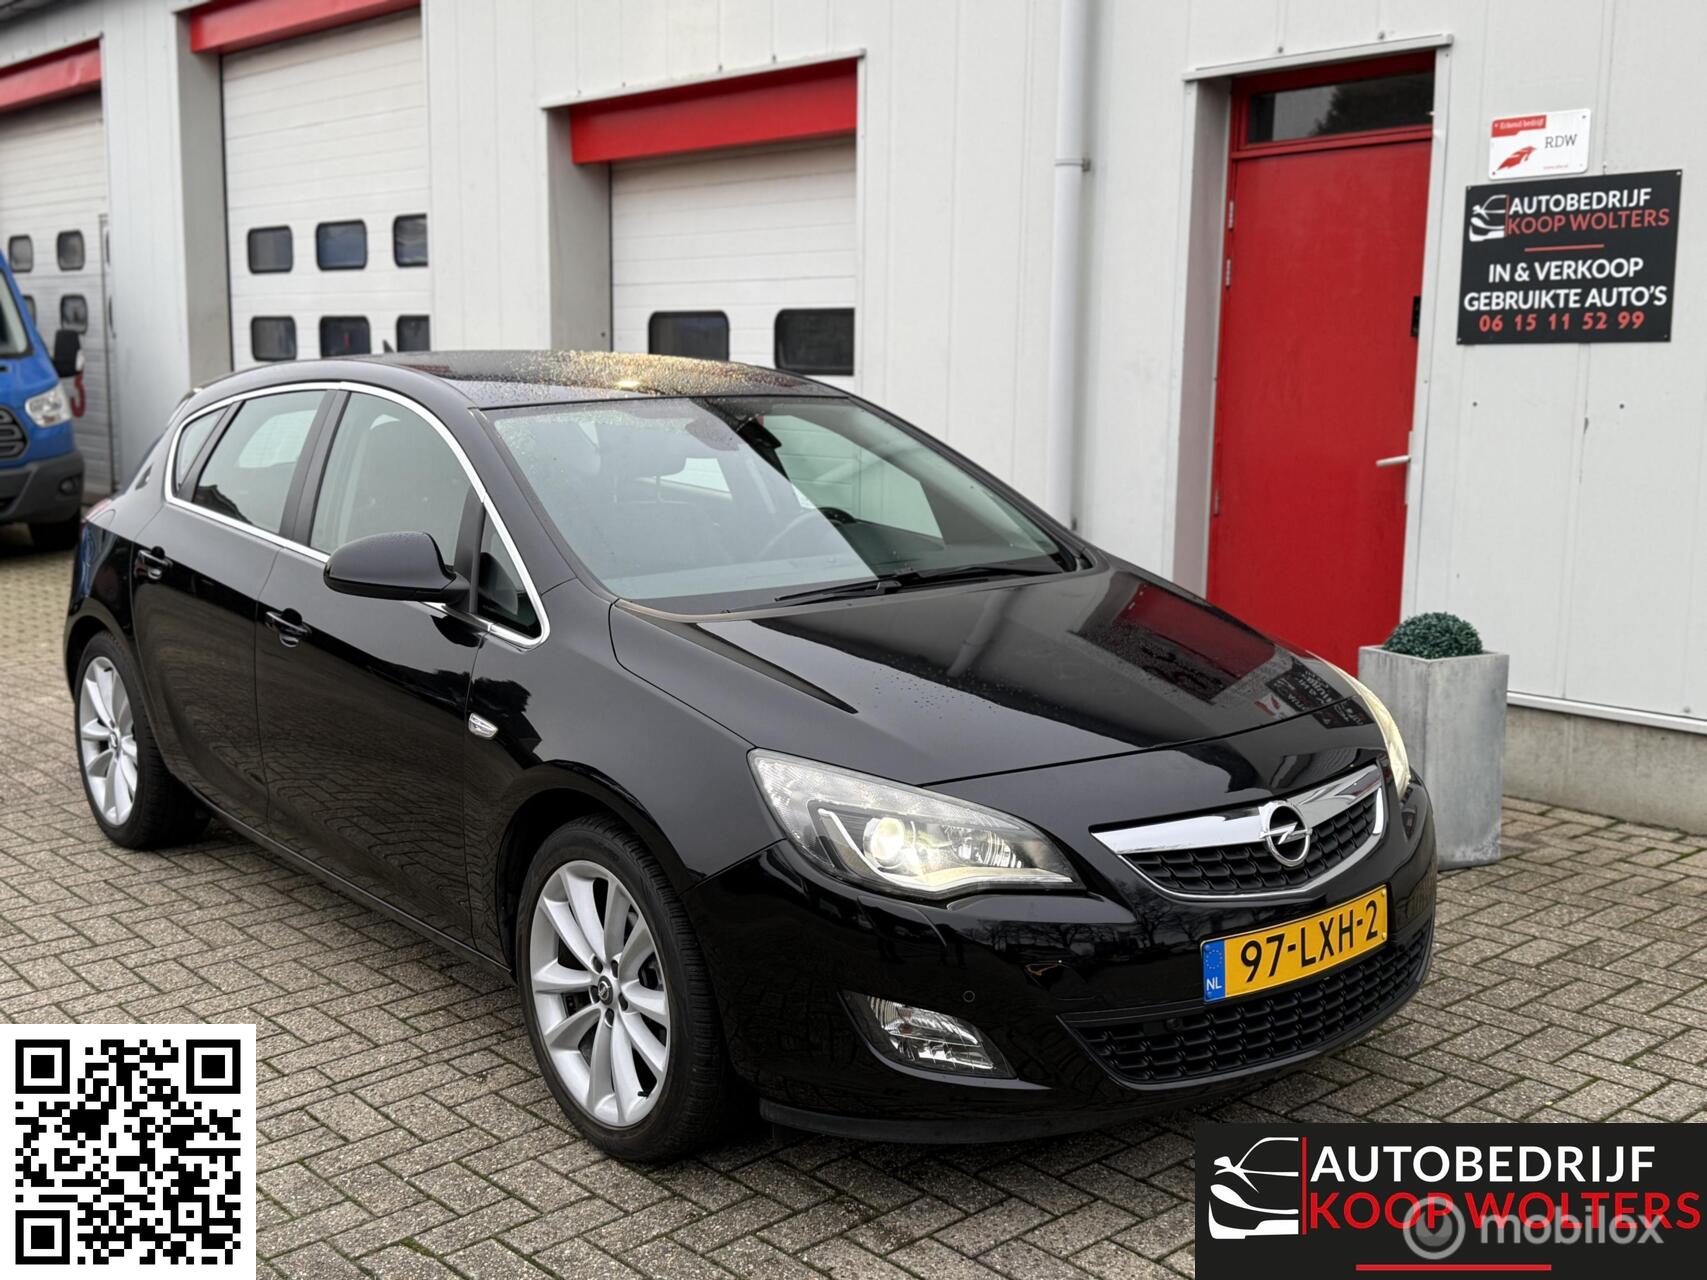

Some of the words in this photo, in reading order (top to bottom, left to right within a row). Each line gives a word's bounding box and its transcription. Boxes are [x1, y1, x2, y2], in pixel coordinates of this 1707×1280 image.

[1545, 134, 1577, 148] RDW
[1509, 188, 1652, 215] AUTOBEDRIJF
[1508, 214, 1566, 235] KOOP
[1569, 208, 1670, 231] WOLTERS
[1488, 264, 1511, 283] IN
[1514, 263, 1530, 282] &
[1534, 257, 1644, 281] VERKOOP
[1463, 288, 1582, 312] GEBRUIKTE
[1584, 285, 1668, 309] AUTO'S
[1479, 314, 1504, 332] 06
[1514, 313, 1537, 331] 15
[1548, 313, 1571, 331] 11
[1582, 312, 1608, 330] 52
[1617, 310, 1645, 329] 99
[1240, 900, 1379, 984] 97-LXH-2
[1206, 976, 1223, 991] NL
